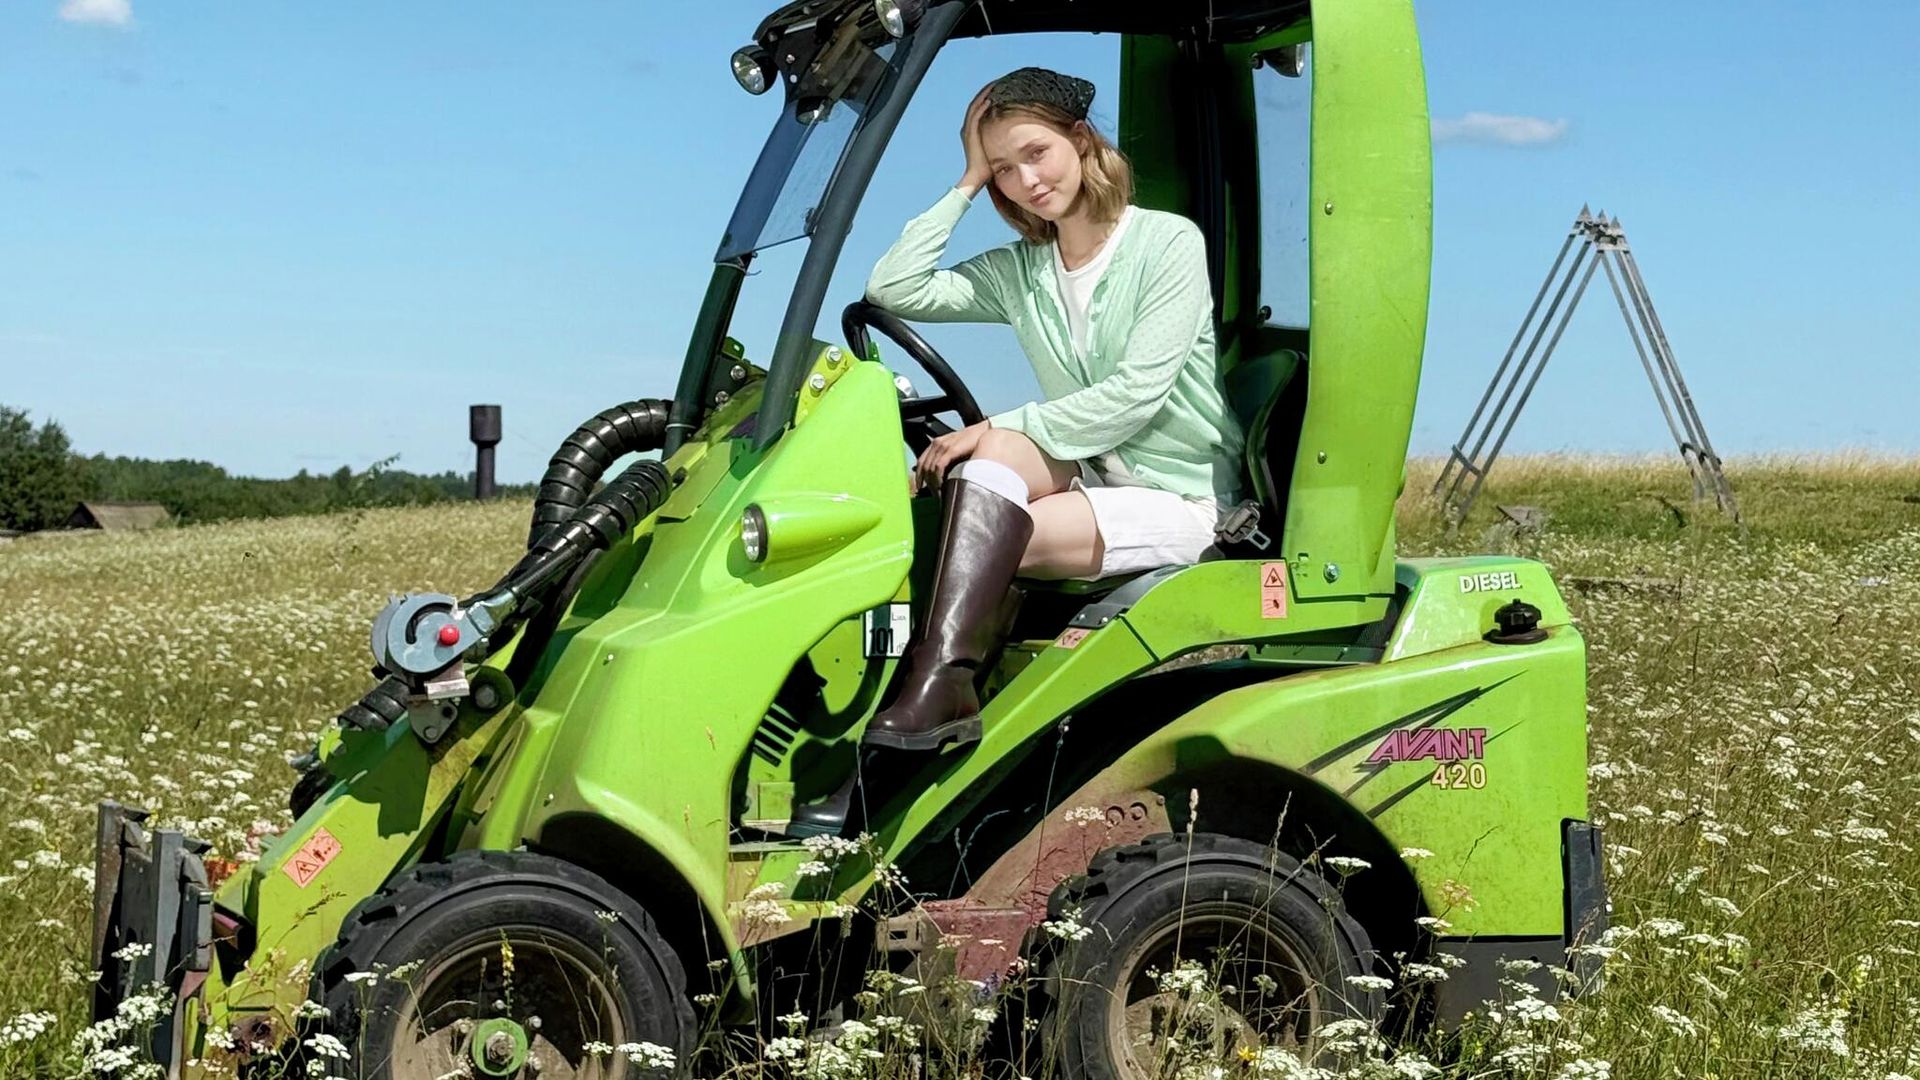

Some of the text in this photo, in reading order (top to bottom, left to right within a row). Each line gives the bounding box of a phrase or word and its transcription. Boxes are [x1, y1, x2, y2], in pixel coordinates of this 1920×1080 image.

[1459, 571, 1522, 593] DIESEL
[869, 627, 894, 654] 101
[1364, 727, 1487, 763] AVANT
[1430, 761, 1487, 790] 420
